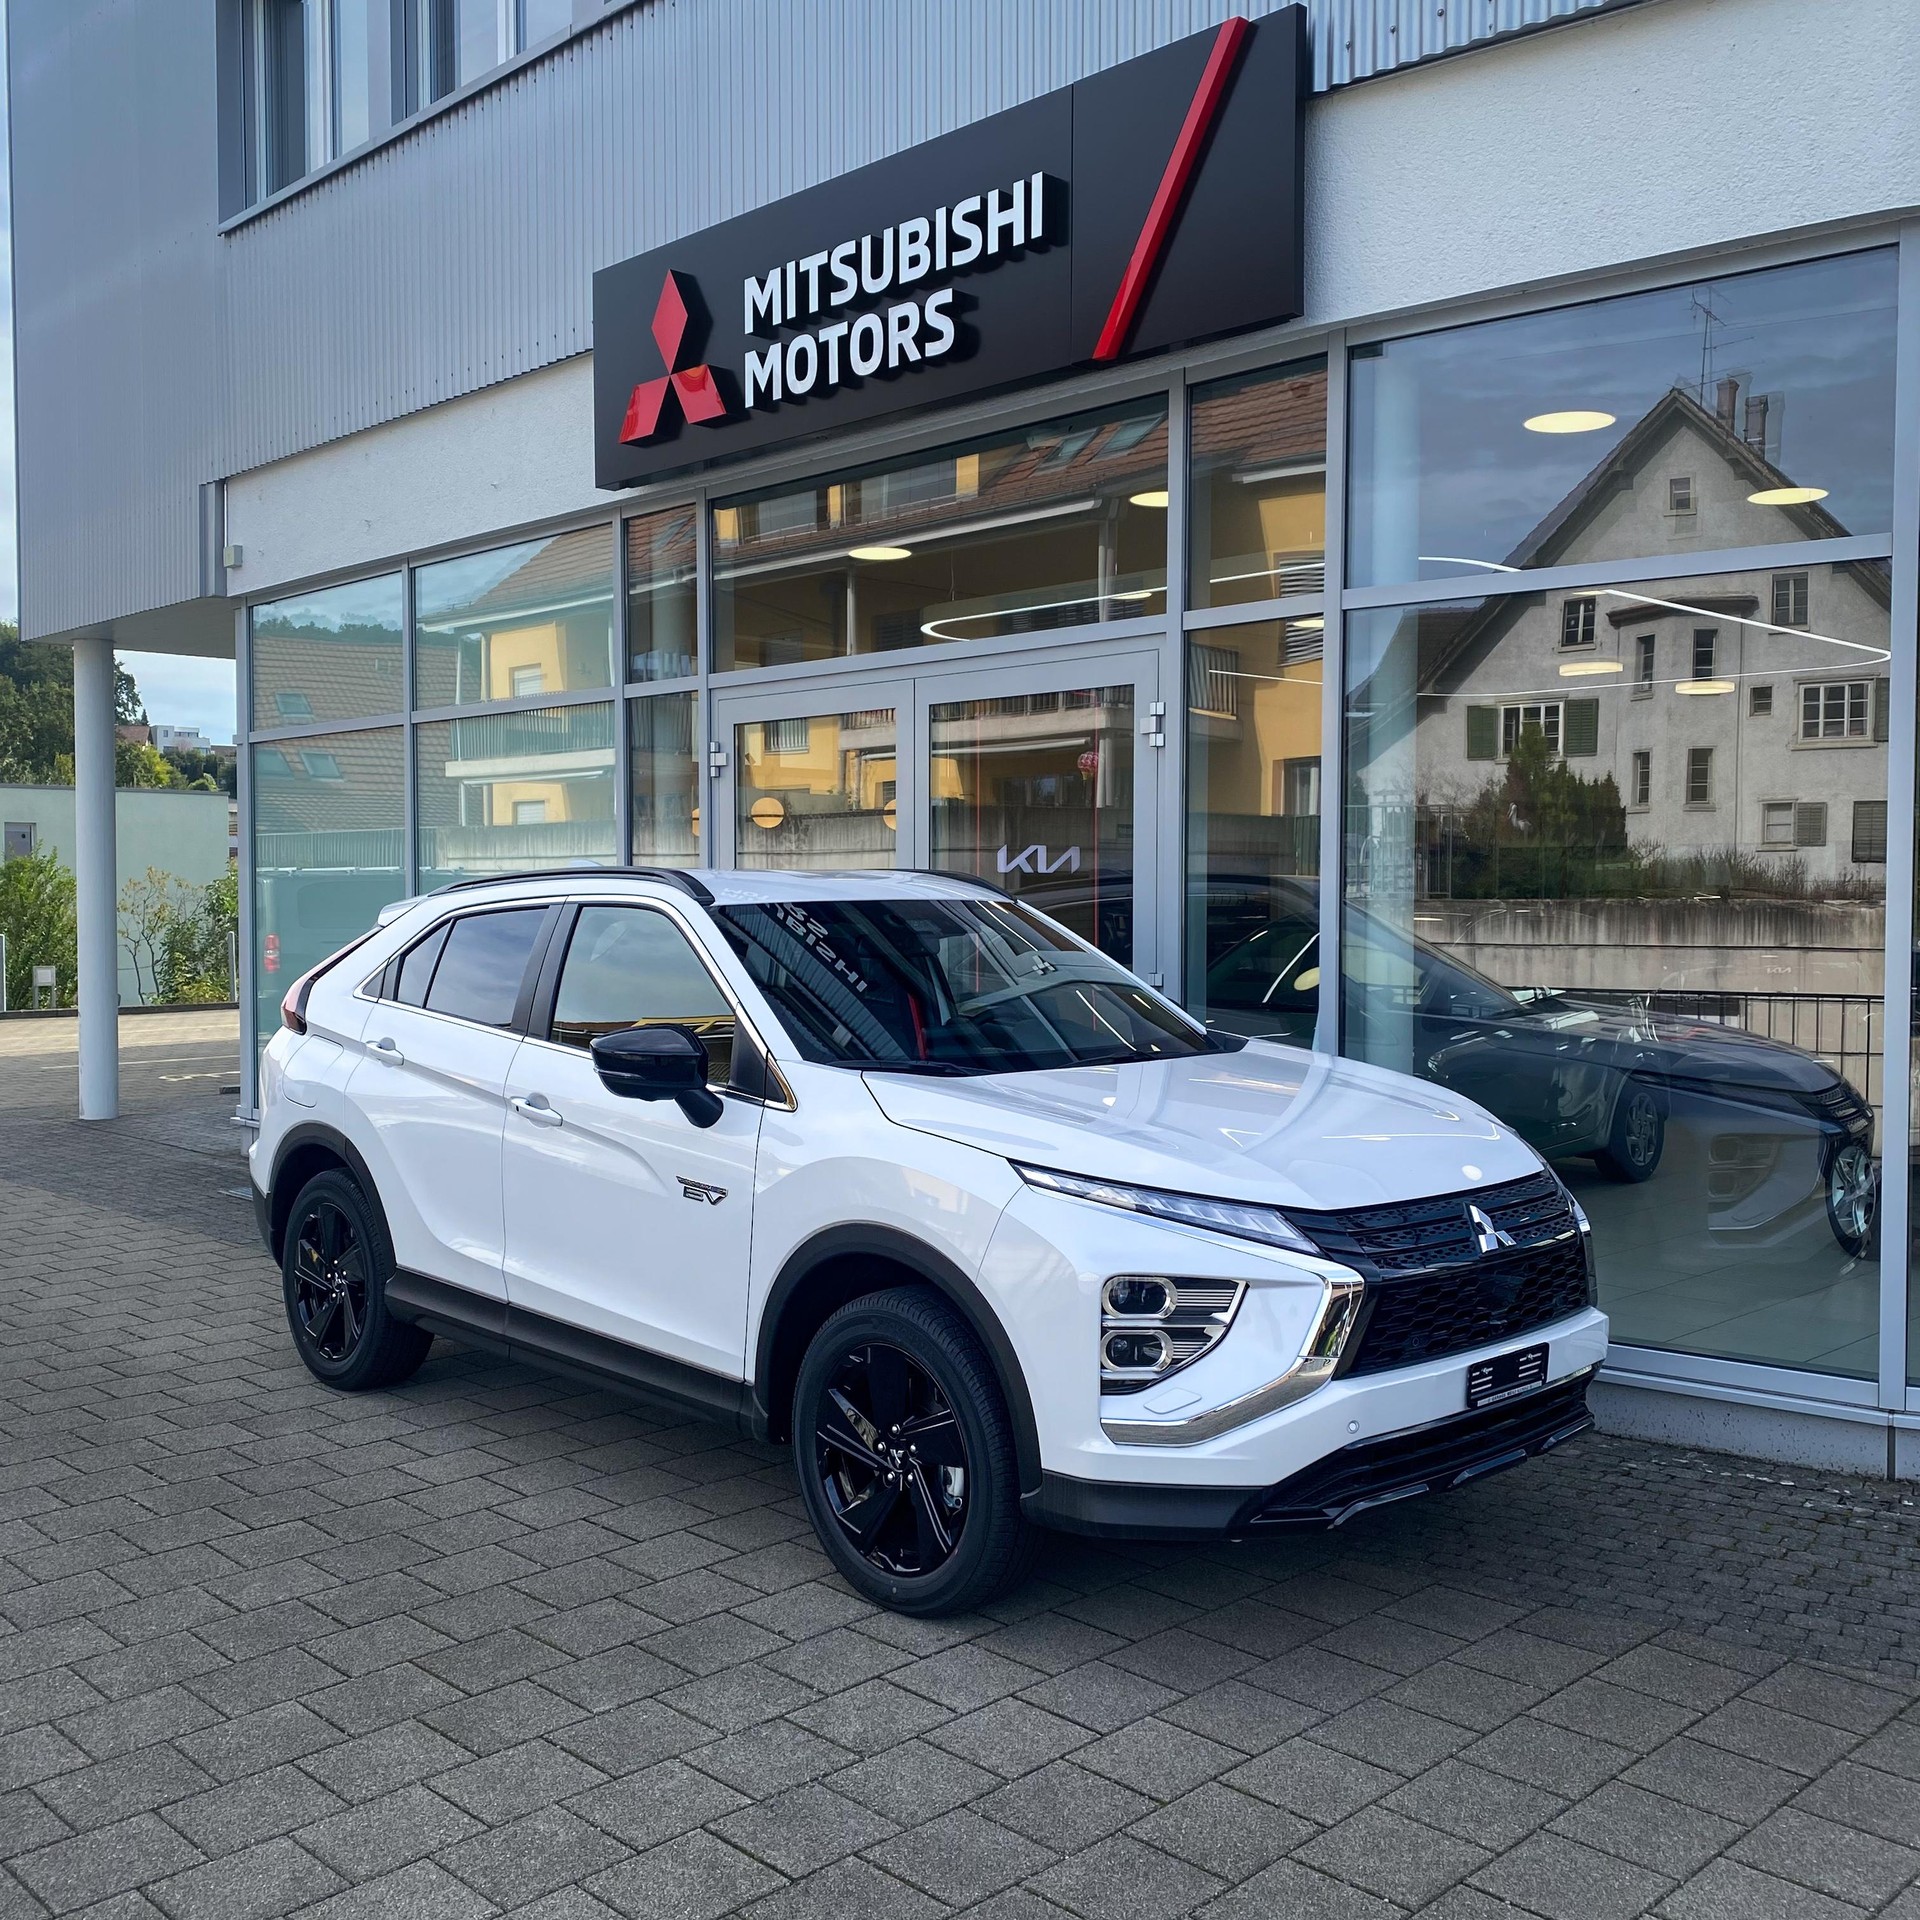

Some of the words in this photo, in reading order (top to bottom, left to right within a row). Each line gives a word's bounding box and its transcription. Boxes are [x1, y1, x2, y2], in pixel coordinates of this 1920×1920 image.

[744, 171, 1043, 335] MITSUBISHI
[745, 288, 955, 408] MOTORS
[997, 844, 1081, 874] KIA
